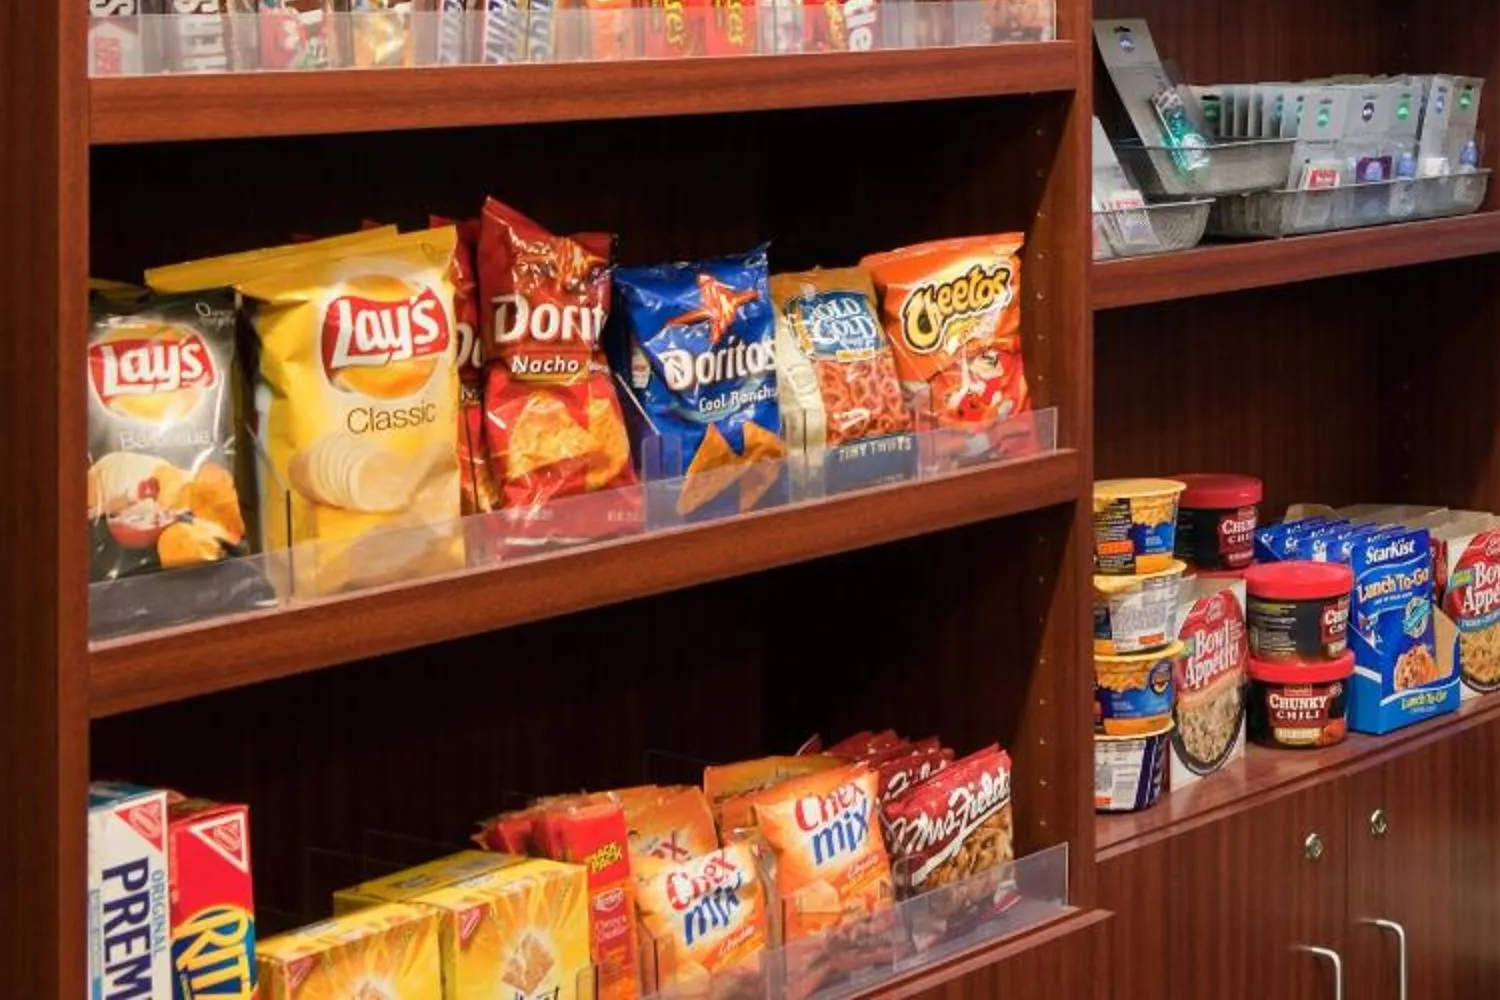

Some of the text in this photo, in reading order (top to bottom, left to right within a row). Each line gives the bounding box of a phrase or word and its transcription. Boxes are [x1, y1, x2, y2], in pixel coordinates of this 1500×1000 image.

[902, 263, 1011, 351] Cheetos
[331, 291, 443, 369] Lay's
[101, 341, 204, 396] Lay's
[511, 355, 580, 375] Nacho
[658, 335, 777, 391] Doritos
[346, 400, 437, 435] Classic
[699, 394, 726, 412] Cool
[1365, 538, 1416, 565] StarKist
[1357, 574, 1395, 602] Lunch
[1195, 619, 1231, 658] Bowl
[1269, 693, 1328, 710] CHUNKY
[1276, 710, 1320, 720] CHILI
[811, 798, 869, 866] mix
[667, 850, 738, 911] Chex
[684, 872, 742, 945] mix
